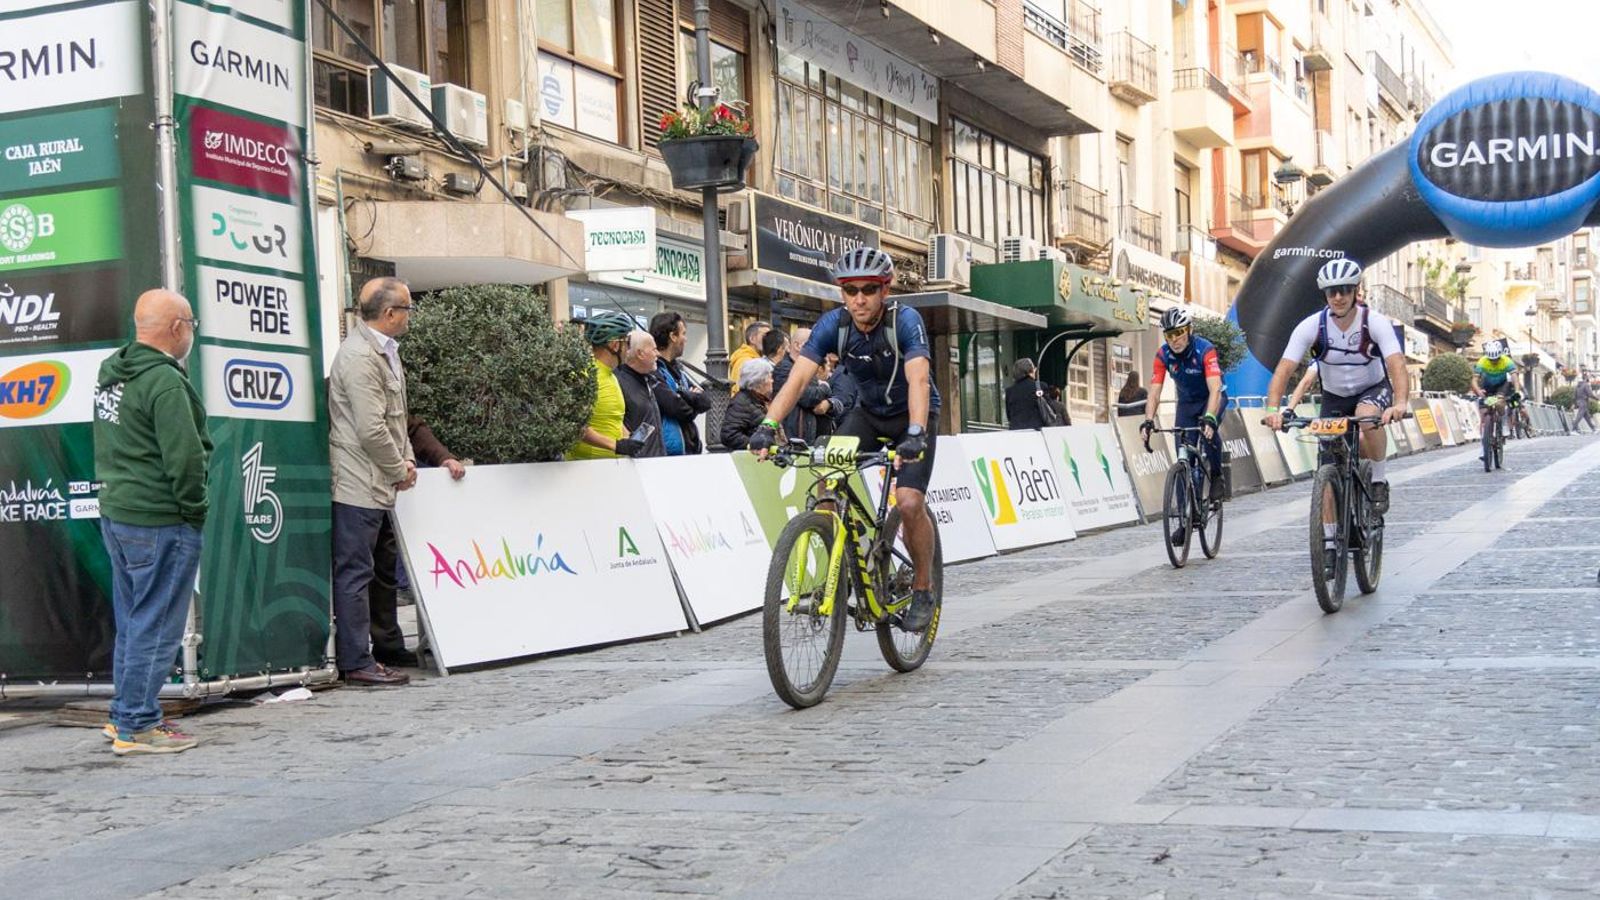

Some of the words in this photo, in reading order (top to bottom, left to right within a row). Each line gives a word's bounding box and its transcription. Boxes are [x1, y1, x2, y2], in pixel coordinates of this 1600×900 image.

[190, 40, 289, 91] GARMIN
[5, 144, 37, 160] CAJA
[39, 137, 84, 157] RURAL
[224, 132, 288, 166] IMDECO
[29, 157, 62, 176] JAÉN
[590, 230, 646, 246] TECNOCASA
[774, 216, 829, 253] VERÓNICA
[829, 232, 837, 254] Y
[1272, 245, 1345, 260] garmin.com
[656, 246, 700, 283] CNOCASA
[216, 279, 288, 311] POWER
[33, 322, 58, 331] HEALTH
[250, 309, 291, 335] ADE
[0, 375, 55, 405] KH-7
[228, 367, 283, 401] CRUZ
[827, 447, 853, 466] 664
[73, 484, 89, 492] UCI
[1003, 456, 1060, 505] Jaén
[242, 441, 283, 544] 15
[926, 486, 971, 504] NTAMIENTO
[24, 502, 67, 521] RACE
[245, 514, 273, 525] YEARS
[934, 508, 954, 525] AÉN
[426, 532, 579, 589] Andalucía
[632, 557, 657, 566] Andalucía
